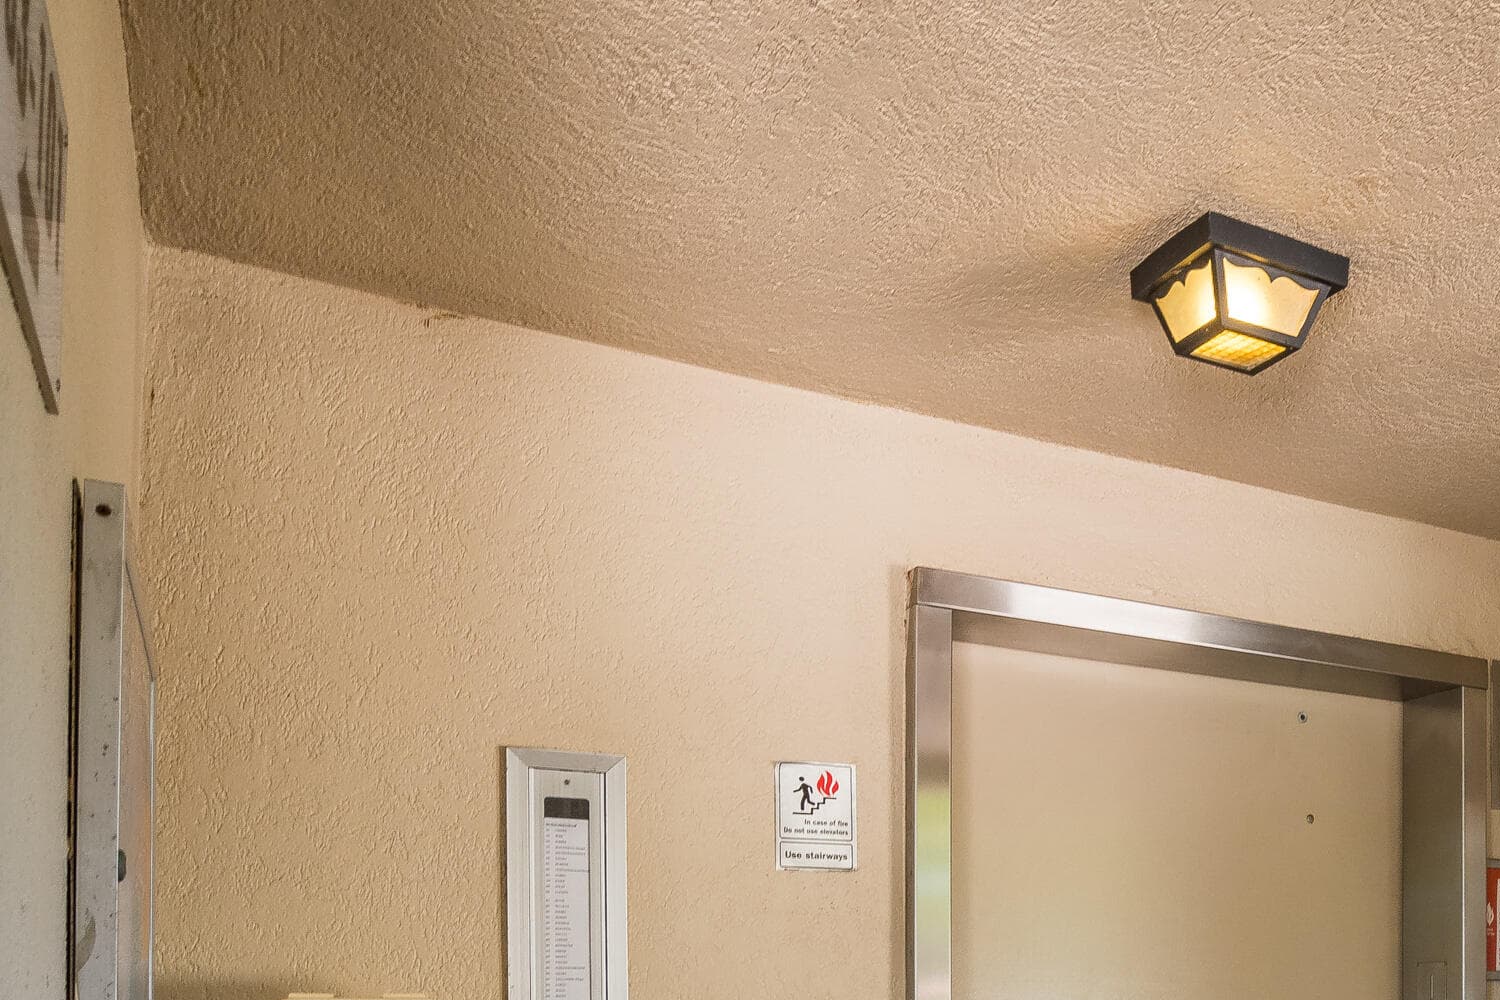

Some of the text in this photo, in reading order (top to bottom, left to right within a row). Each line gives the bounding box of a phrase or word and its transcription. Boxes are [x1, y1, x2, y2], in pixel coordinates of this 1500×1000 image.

[819, 828, 849, 836] elevators
[784, 850, 848, 862] Use stairways
